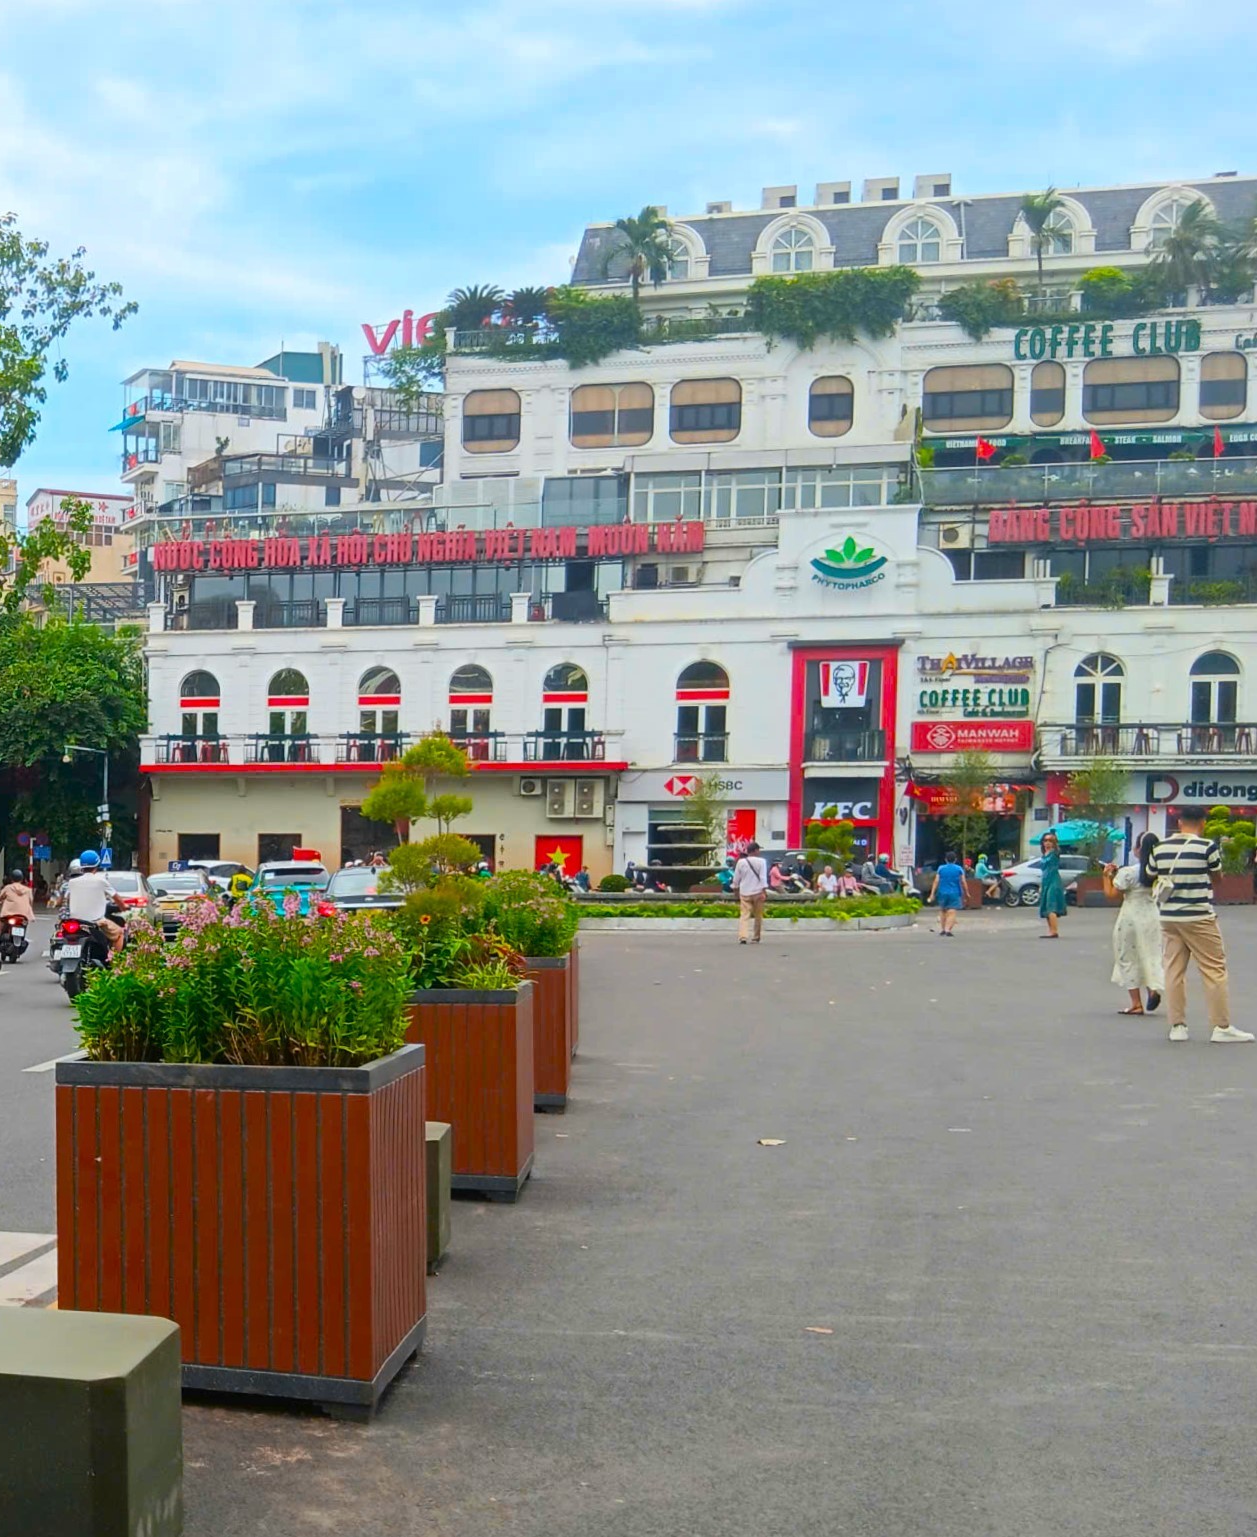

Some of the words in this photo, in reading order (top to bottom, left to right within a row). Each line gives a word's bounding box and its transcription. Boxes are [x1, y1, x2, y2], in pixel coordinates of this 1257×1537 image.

[1014, 324, 1114, 360] COFFEE
[1132, 319, 1201, 356] CLUB
[1152, 434, 1182, 443] SALMON
[1060, 498, 1120, 546] CỘNG
[1131, 495, 1178, 541] SẢN
[1185, 495, 1232, 543] VIỆT
[209, 532, 258, 575] CỘNG
[307, 529, 331, 567] XÃ
[336, 526, 368, 570] HỘI
[374, 523, 412, 564] CHỦ
[418, 523, 476, 564] NGHĨA
[485, 521, 526, 568] VIỆT
[530, 526, 576, 559] NAM
[588, 514, 649, 557] MUÔN
[657, 513, 705, 554] NĂM
[812, 572, 885, 590] PHYTOPHARCO
[919, 689, 981, 707] COFFEE
[957, 729, 1019, 738] MANWAH
[709, 781, 743, 790] HSBC
[1183, 781, 1257, 802] didong
[813, 802, 873, 819] KFC
